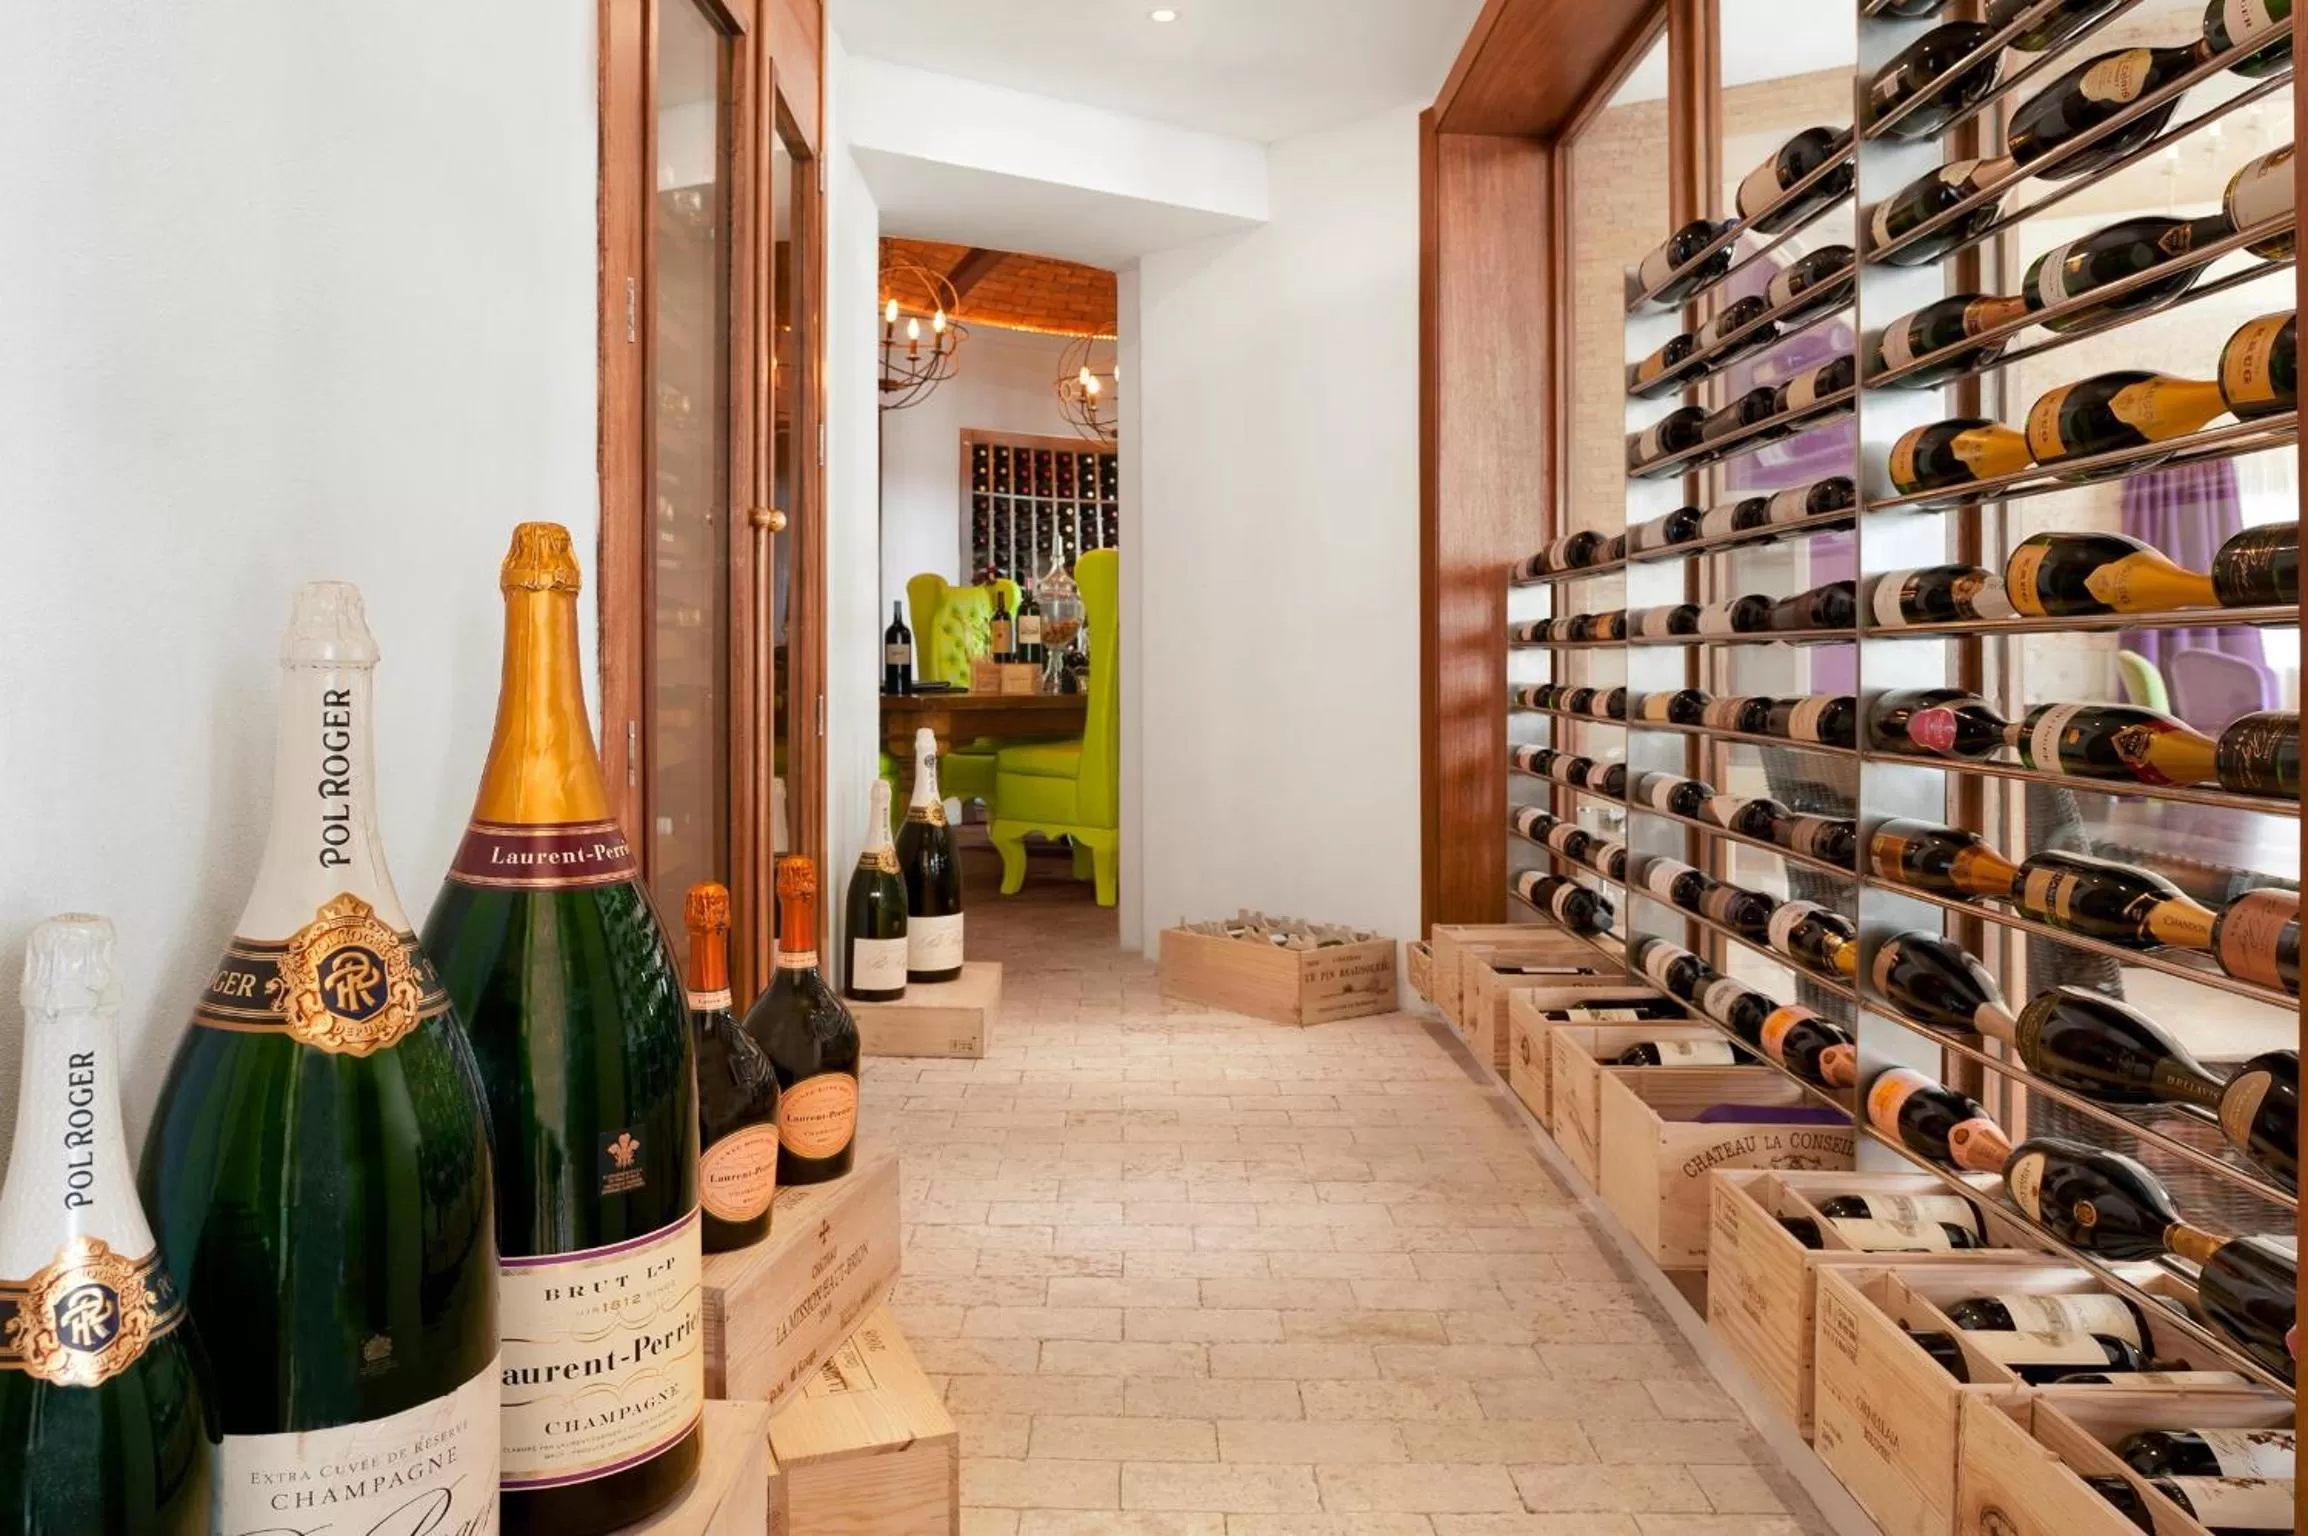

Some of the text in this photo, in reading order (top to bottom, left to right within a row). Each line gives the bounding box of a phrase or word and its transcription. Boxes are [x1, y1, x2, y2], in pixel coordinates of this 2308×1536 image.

[2243, 327, 2266, 385] KRUG
[319, 688, 351, 870] POL ROGER
[2163, 915, 2208, 936] CHANDON
[209, 970, 257, 998] GER
[64, 1050, 95, 1210] POL ROGER
[1682, 1135, 1757, 1178] CHATEAU
[1763, 1135, 1783, 1150] LA
[544, 1274, 630, 1302] BRUT
[646, 1256, 676, 1280] L-P
[603, 1293, 642, 1313] 1812
[502, 1308, 701, 1387] aurent-Perrie
[544, 1382, 680, 1436] CHAMPAGNE
[250, 1470, 312, 1486] EXTRA
[386, 1448, 408, 1465] DE
[270, 1445, 458, 1513] CHAMPAGNE
